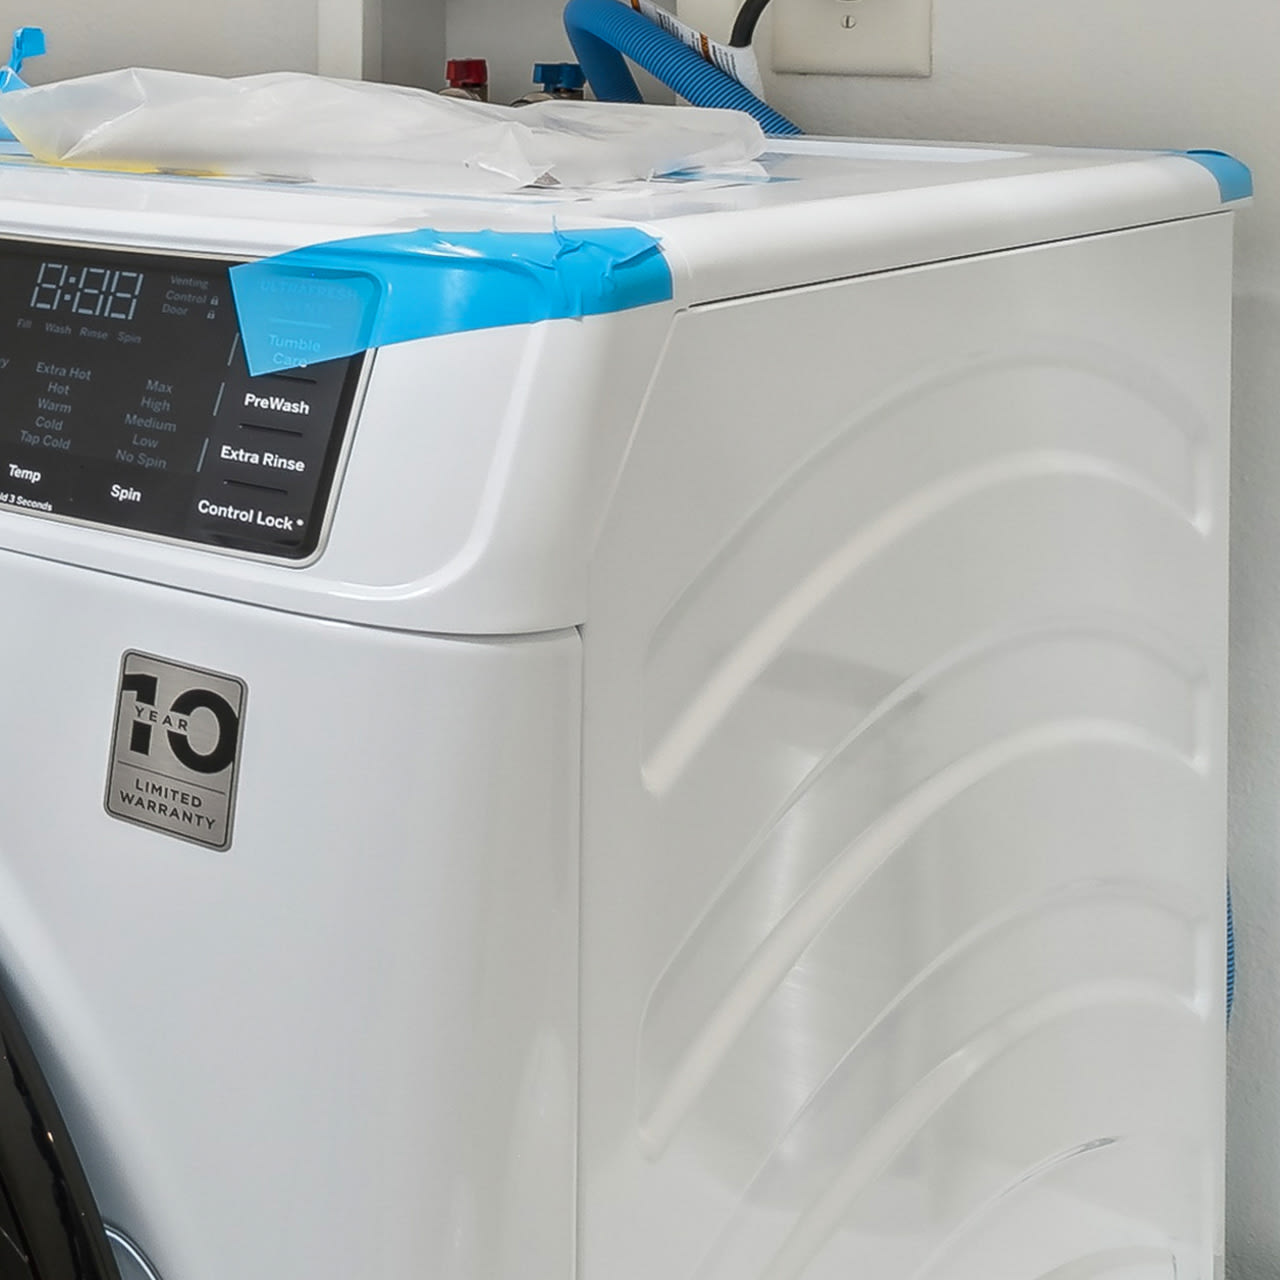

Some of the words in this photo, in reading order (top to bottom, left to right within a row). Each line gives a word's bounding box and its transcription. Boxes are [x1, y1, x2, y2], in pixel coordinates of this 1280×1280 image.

[170, 275, 209, 290] Venting
[165, 290, 207, 304] Control
[162, 304, 188, 316] Door
[17, 318, 32, 329] Fill
[45, 322, 72, 335] Wash
[79, 327, 109, 340] Rinse
[116, 331, 141, 345] Spin
[269, 334, 320, 352] Tumble
[273, 352, 307, 369] Care
[36, 361, 66, 377] Extra
[69, 367, 92, 381] Hot
[47, 382, 70, 395] Hot
[145, 379, 173, 394] Max
[38, 398, 72, 413] Warm
[141, 396, 171, 412] High
[244, 393, 311, 416] PreWash
[35, 416, 64, 432] Cold
[124, 413, 177, 433] Medium
[20, 429, 41, 447] Tap
[43, 434, 71, 450] Cold
[132, 434, 159, 449] Low
[116, 448, 135, 463] No
[137, 452, 168, 469] Spin
[220, 445, 260, 465] Extra
[262, 452, 306, 472] Rinse
[8, 463, 42, 483] Temp
[110, 484, 142, 502] Spin
[9, 494, 16, 504] 3
[16, 496, 53, 512] Seconds
[197, 499, 254, 524] Control
[257, 511, 293, 531] Lock
[121, 673, 240, 774] 10
[135, 705, 188, 732] YEAR
[135, 778, 203, 808] LIMITED
[119, 790, 216, 830] WARRANTY
